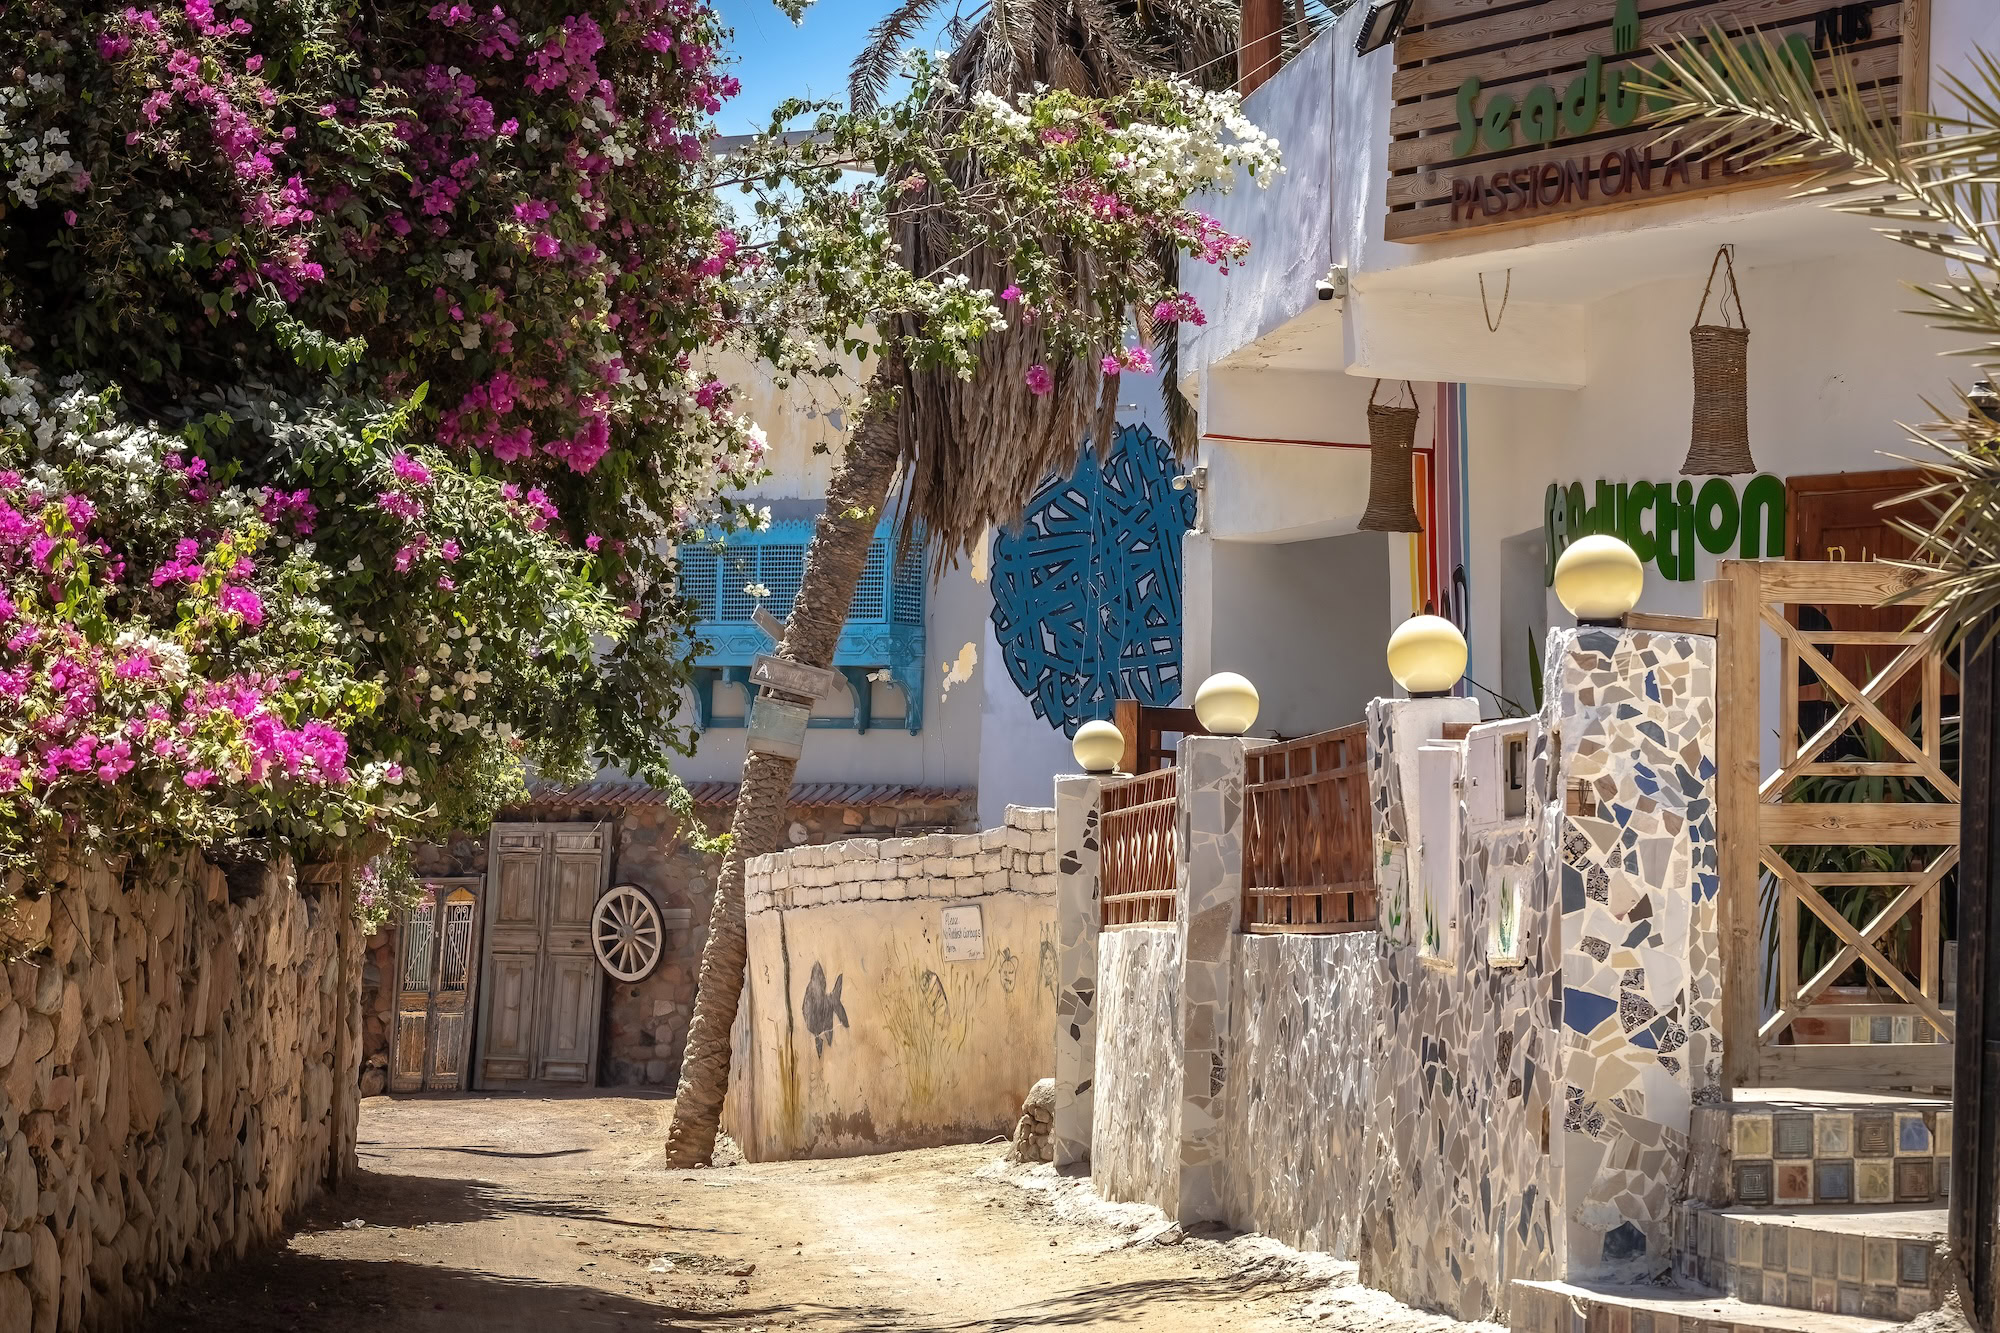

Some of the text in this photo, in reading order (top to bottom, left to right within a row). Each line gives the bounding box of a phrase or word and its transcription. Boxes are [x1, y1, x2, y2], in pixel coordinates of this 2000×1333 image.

[1451, 156, 1591, 221] PASSION
[1599, 144, 1652, 196] ON
[1662, 139, 1691, 187] A
